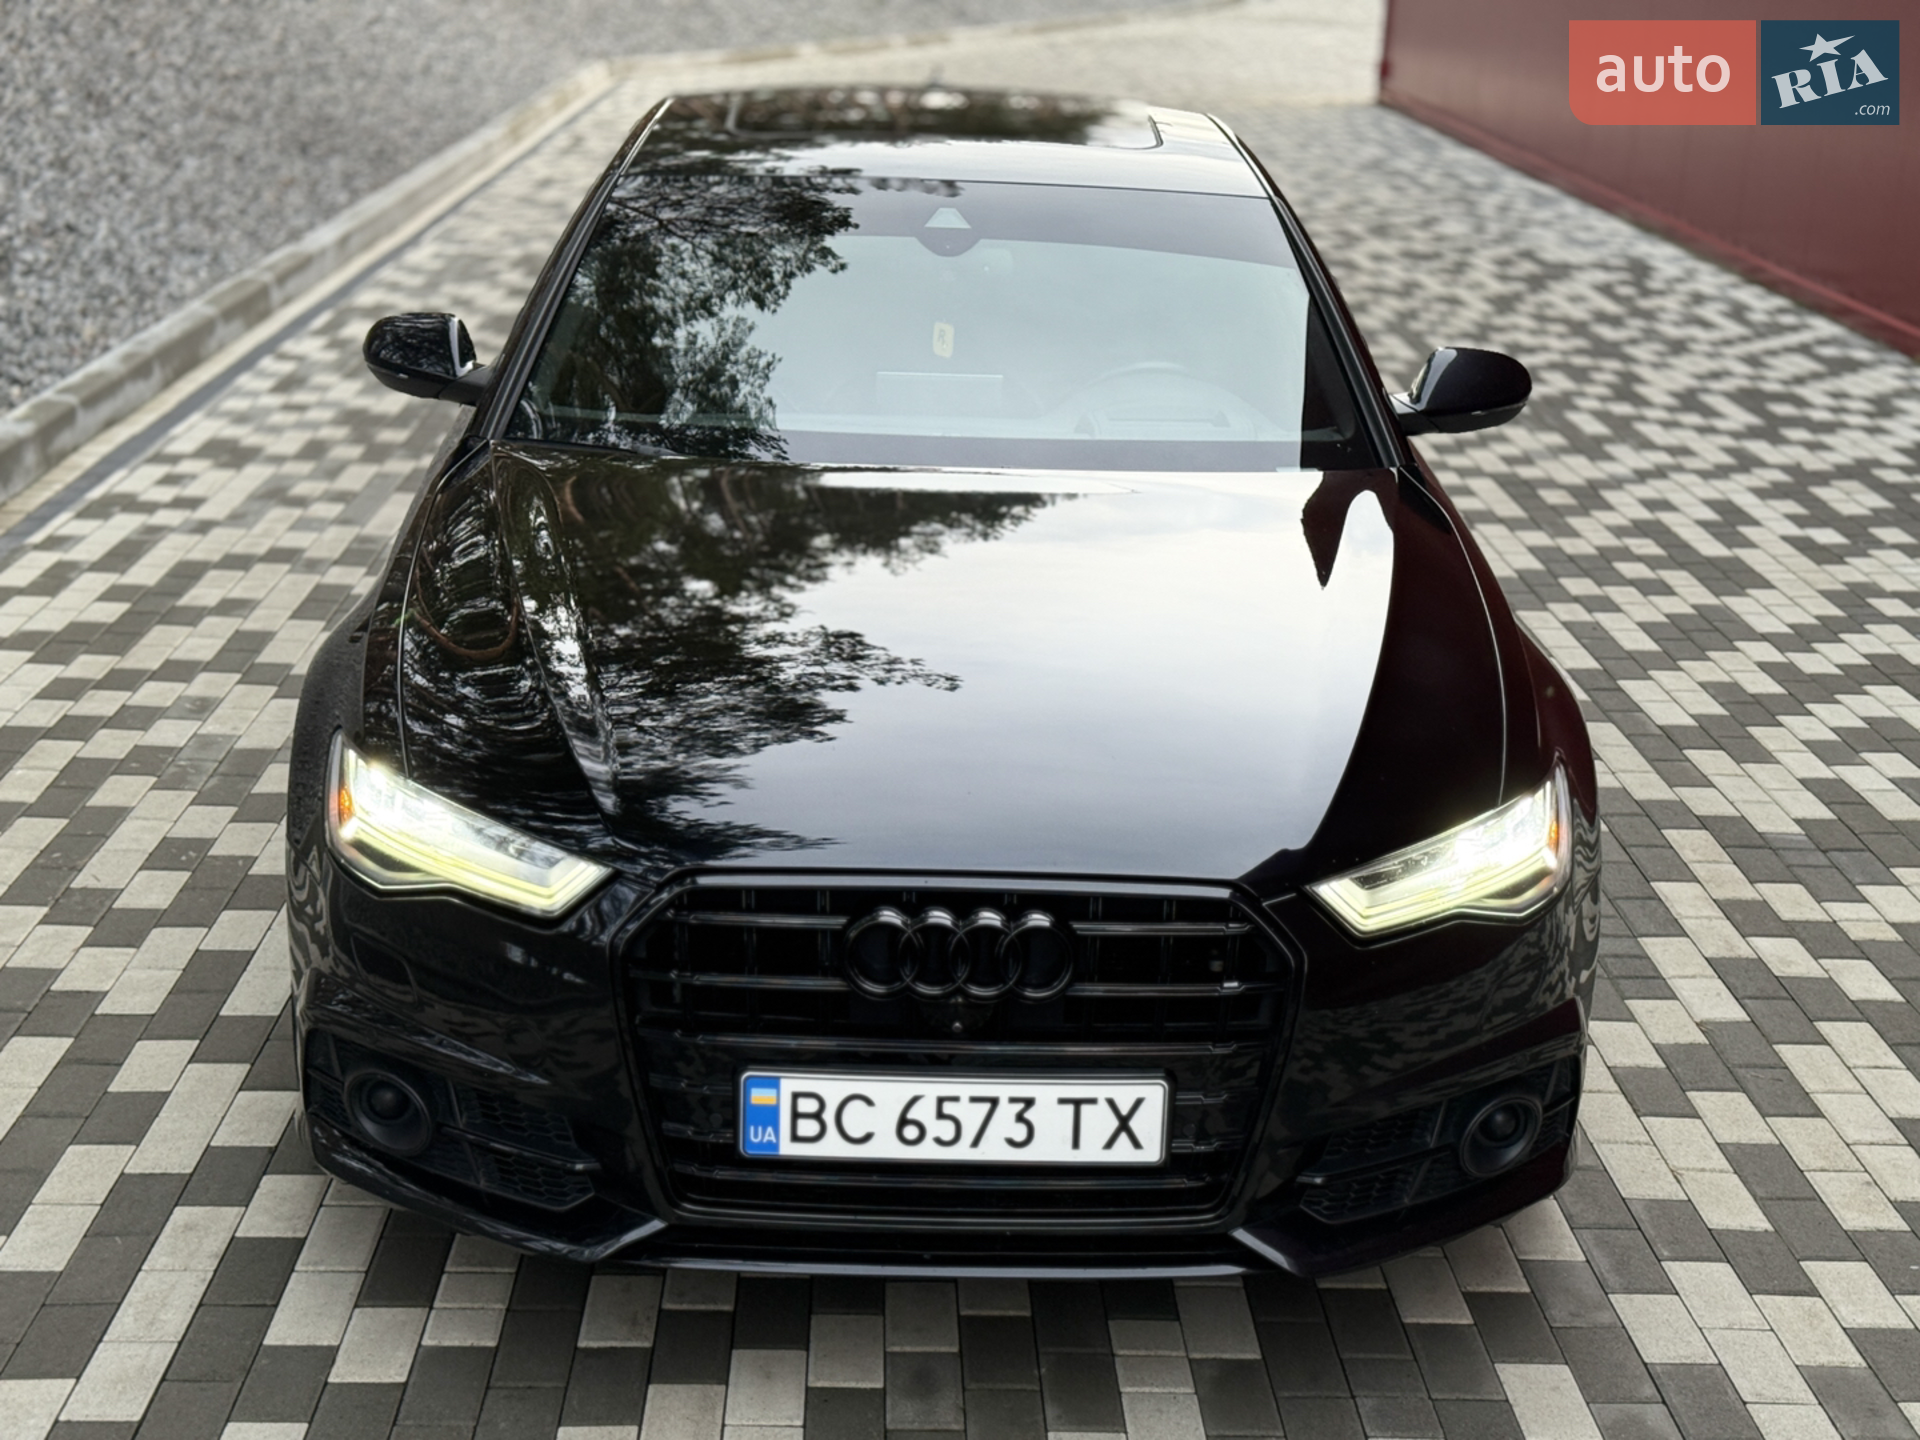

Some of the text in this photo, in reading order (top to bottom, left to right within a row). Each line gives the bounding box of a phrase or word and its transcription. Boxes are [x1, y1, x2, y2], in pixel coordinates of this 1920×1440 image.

[749, 1125, 777, 1144] UA
[790, 1091, 1146, 1150] BC 6573 TX
